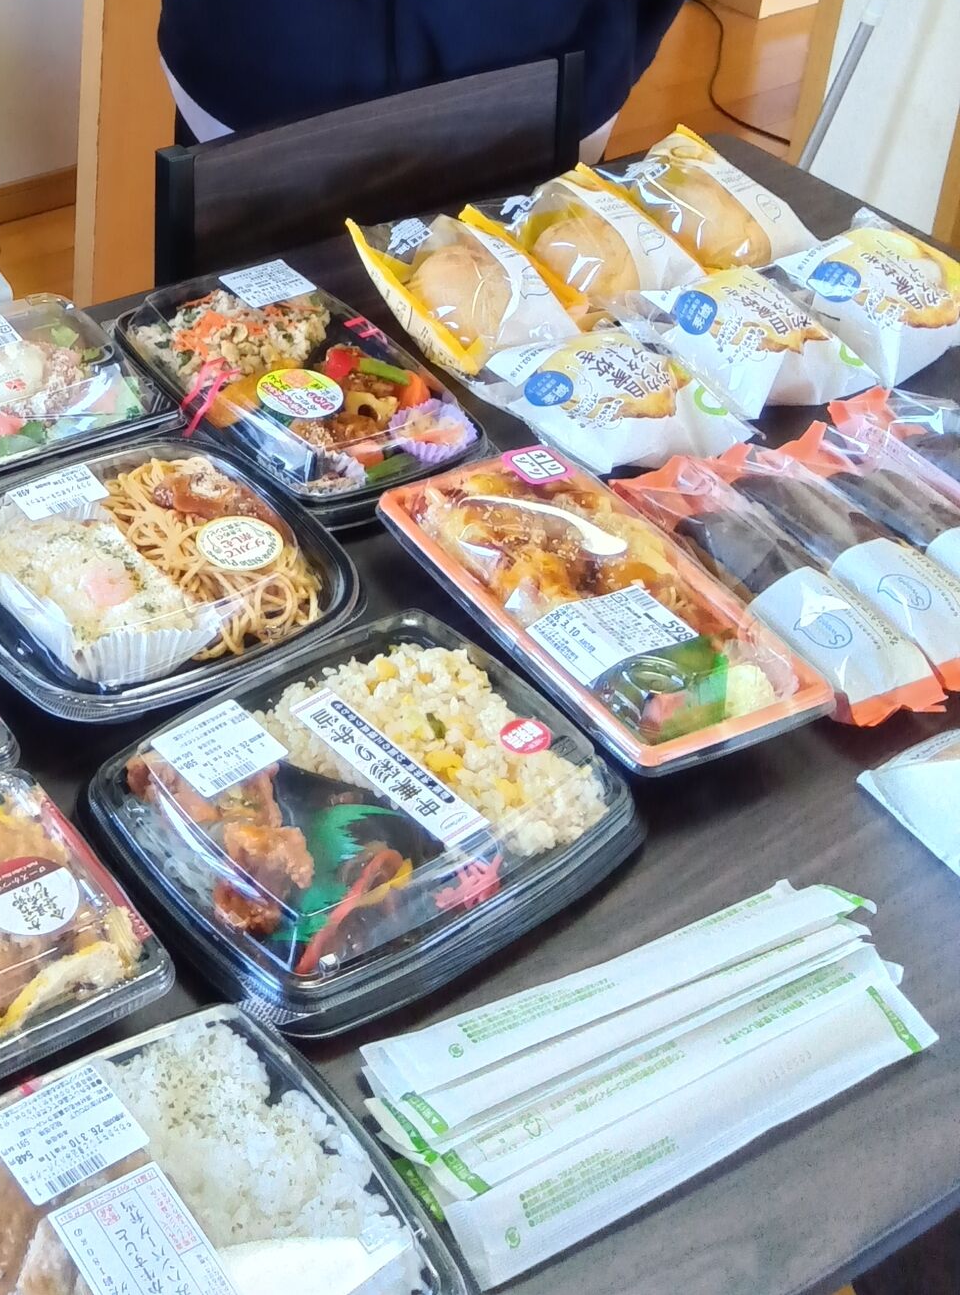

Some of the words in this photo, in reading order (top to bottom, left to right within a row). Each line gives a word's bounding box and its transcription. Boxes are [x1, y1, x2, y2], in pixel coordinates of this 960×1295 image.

[662, 619, 693, 639] 598
[306, 706, 446, 821] 中華彩り弁当
